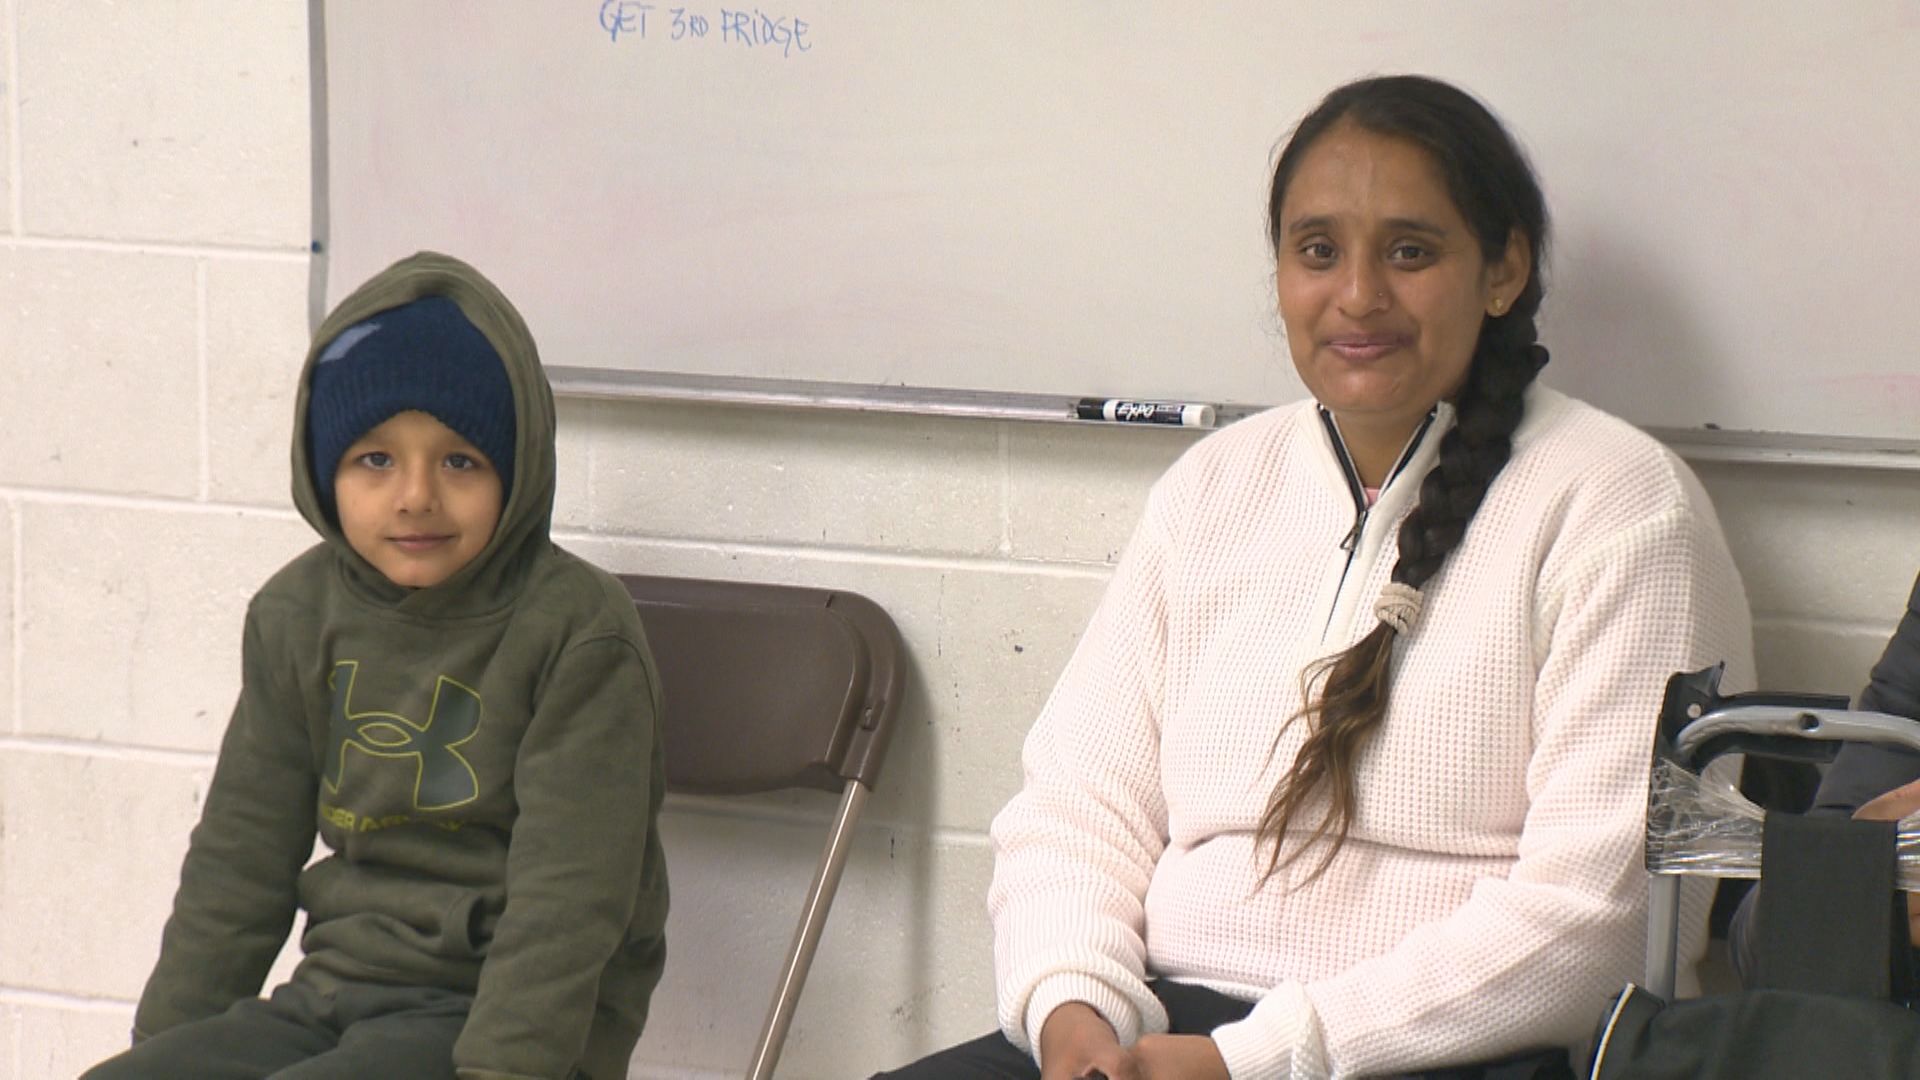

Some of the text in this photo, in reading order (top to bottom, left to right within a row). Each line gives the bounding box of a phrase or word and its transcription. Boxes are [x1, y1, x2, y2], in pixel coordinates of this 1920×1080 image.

[599, 0, 655, 43] GET
[669, 8, 709, 41] 3RD
[1117, 403, 1155, 421] EXPO
